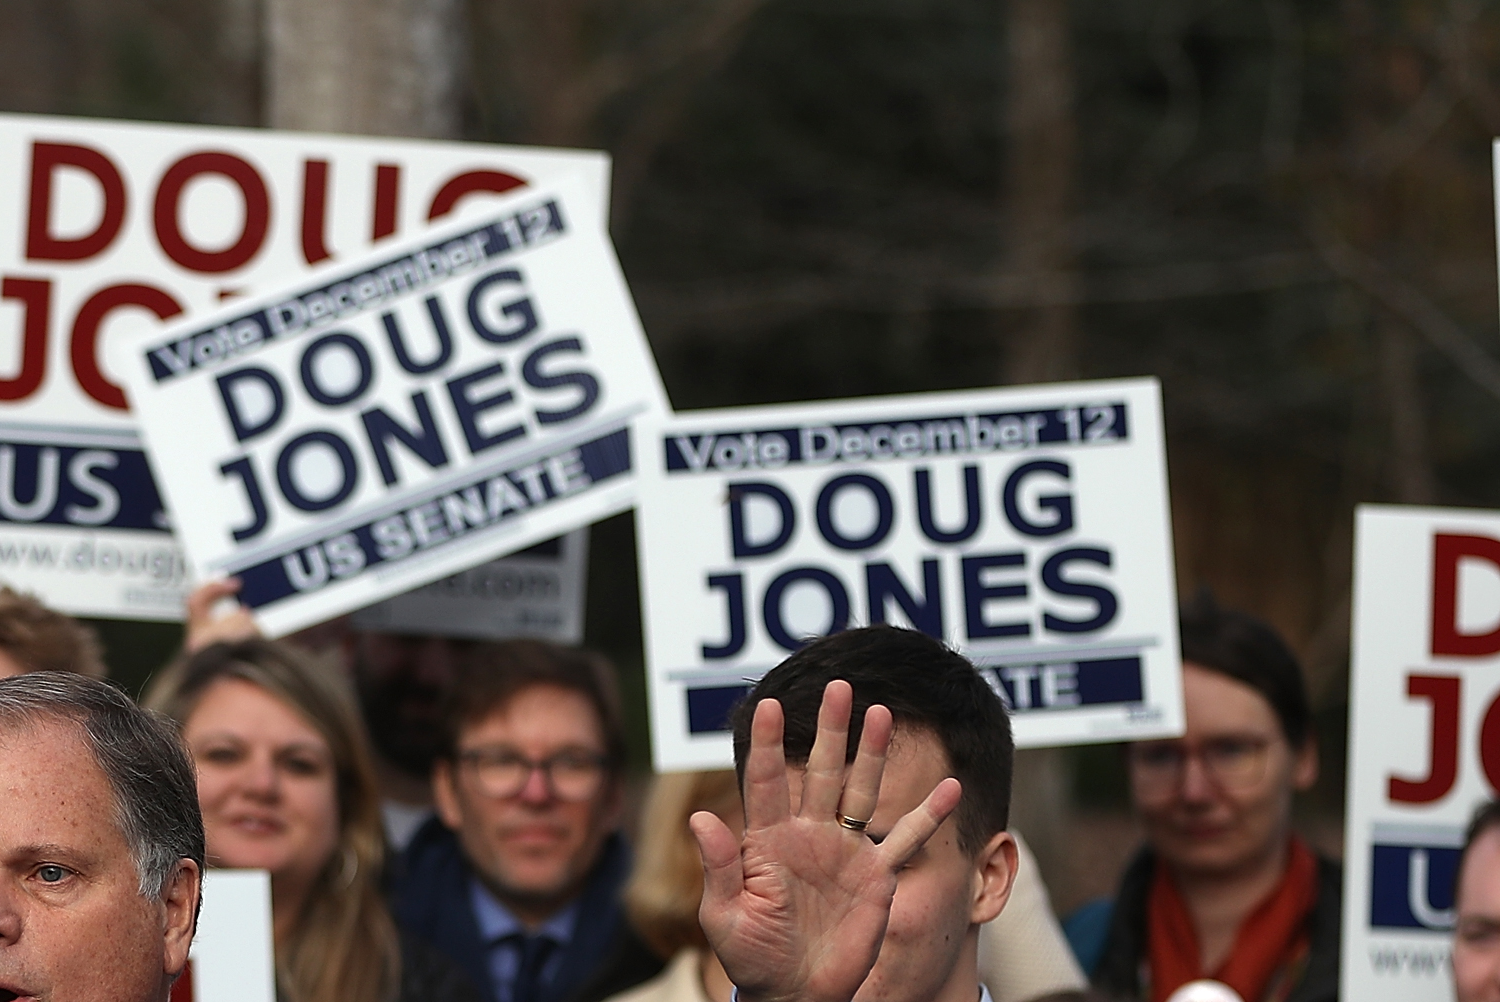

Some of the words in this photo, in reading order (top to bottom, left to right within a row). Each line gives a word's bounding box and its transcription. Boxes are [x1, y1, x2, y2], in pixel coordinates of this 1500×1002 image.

[22, 140, 532, 275] DOU
[156, 317, 265, 375] Vote
[269, 229, 492, 334] December
[499, 205, 554, 250] 12
[216, 270, 541, 442] DOUG
[219, 336, 600, 543] JONES
[674, 432, 791, 471] Vote
[802, 413, 1047, 463] December
[1059, 404, 1118, 443] 12
[281, 533, 367, 592] US
[370, 450, 592, 562] SENATE
[728, 460, 1075, 560] DOUG
[701, 547, 1118, 659] JONES
